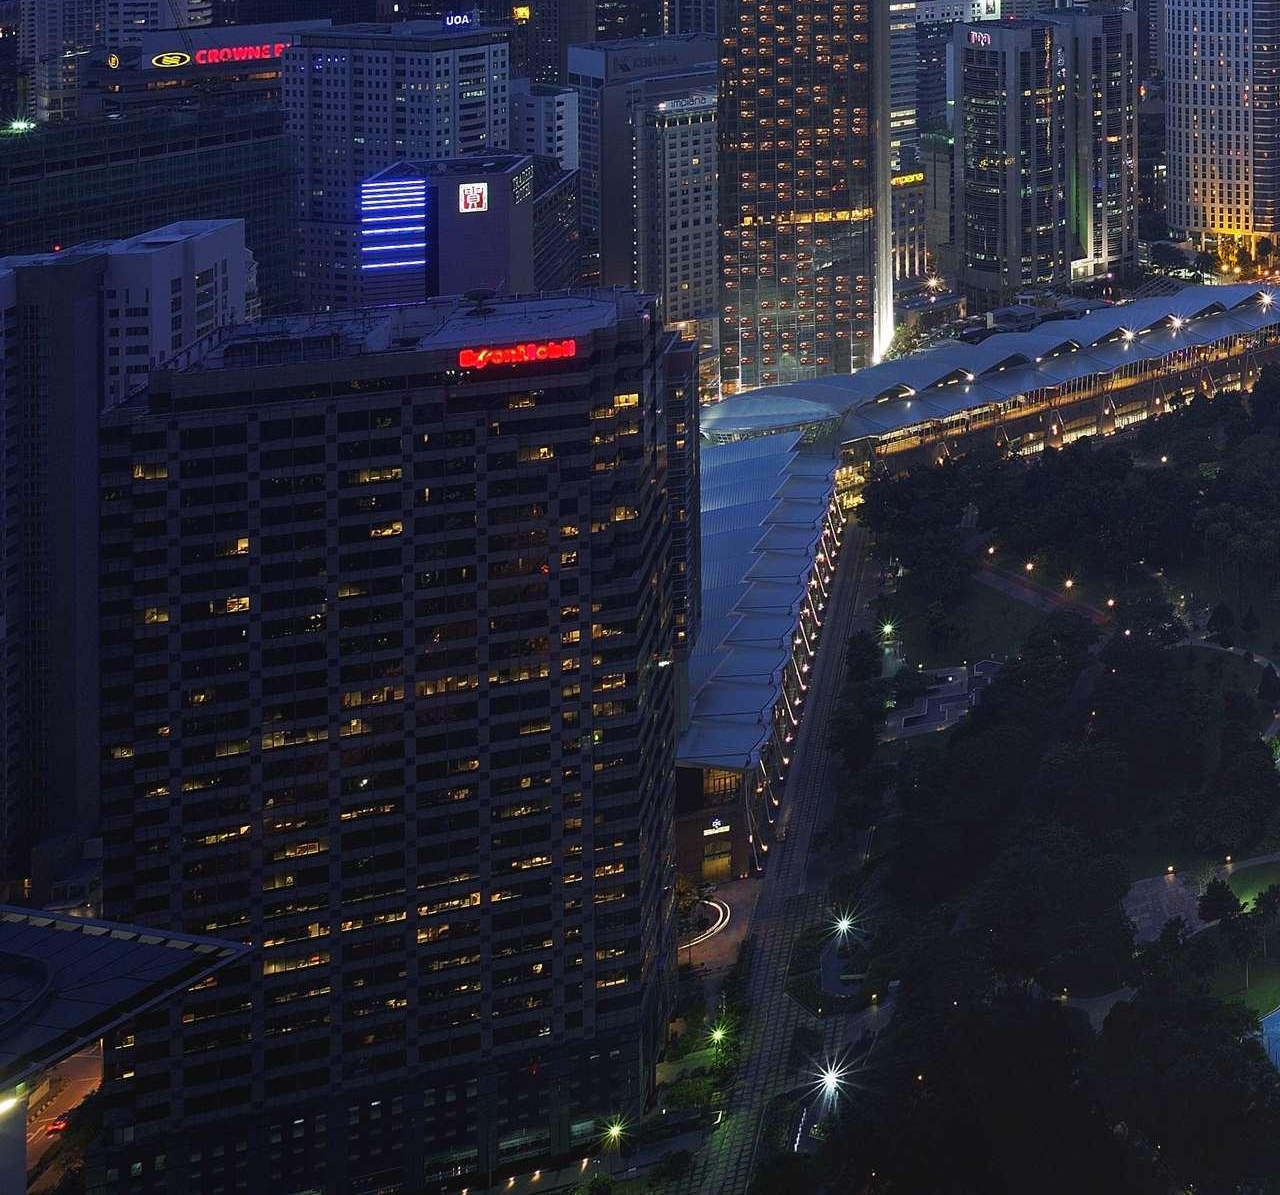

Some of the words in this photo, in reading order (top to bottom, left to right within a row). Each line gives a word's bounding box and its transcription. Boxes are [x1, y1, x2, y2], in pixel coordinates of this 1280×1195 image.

[446, 15, 470, 25] UOA
[194, 43, 271, 66] CROWNE
[671, 96, 706, 108] impiana
